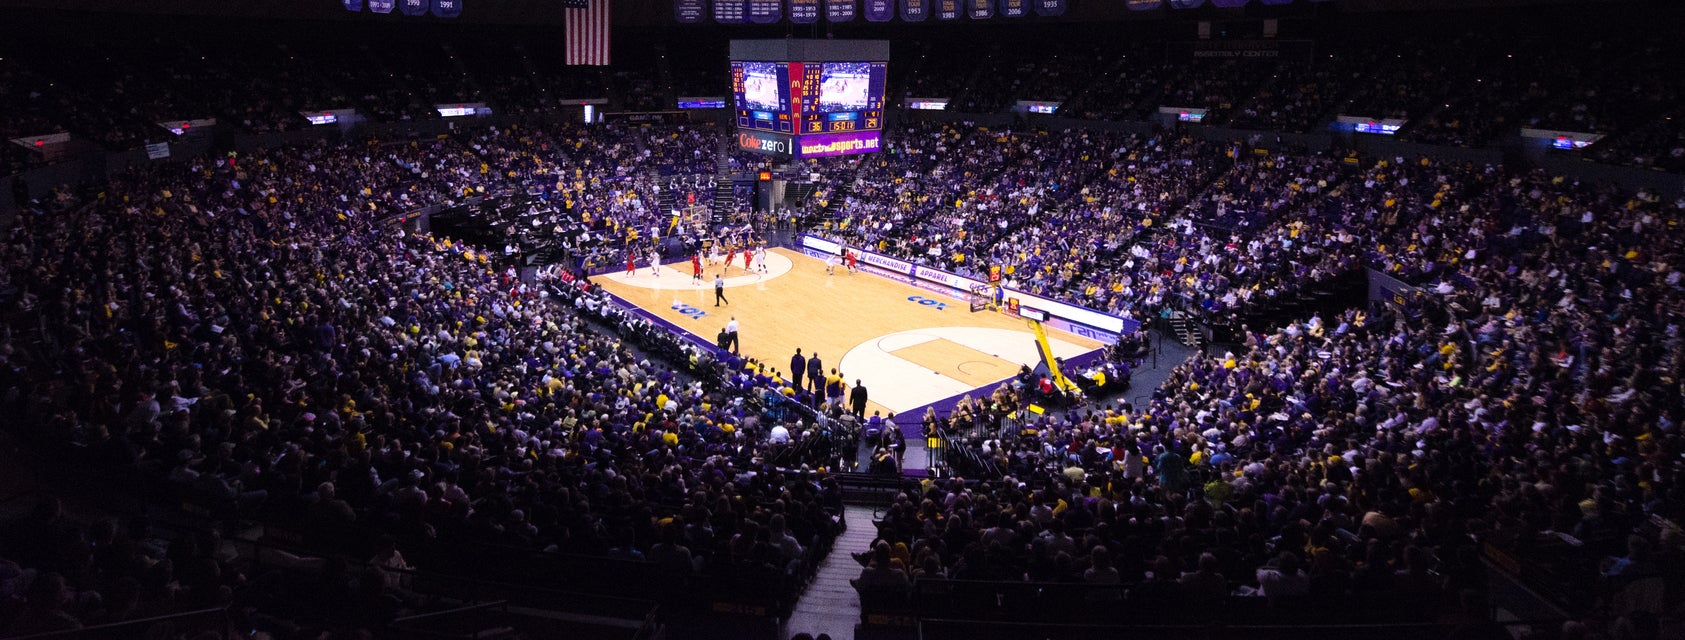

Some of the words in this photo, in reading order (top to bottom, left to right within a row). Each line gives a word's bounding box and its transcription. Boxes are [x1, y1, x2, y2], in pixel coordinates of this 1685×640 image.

[739, 133, 761, 150] Coke
[761, 139, 785, 153] zero
[868, 255, 907, 271] MERCHANDISE
[919, 269, 949, 282] APPAREL
